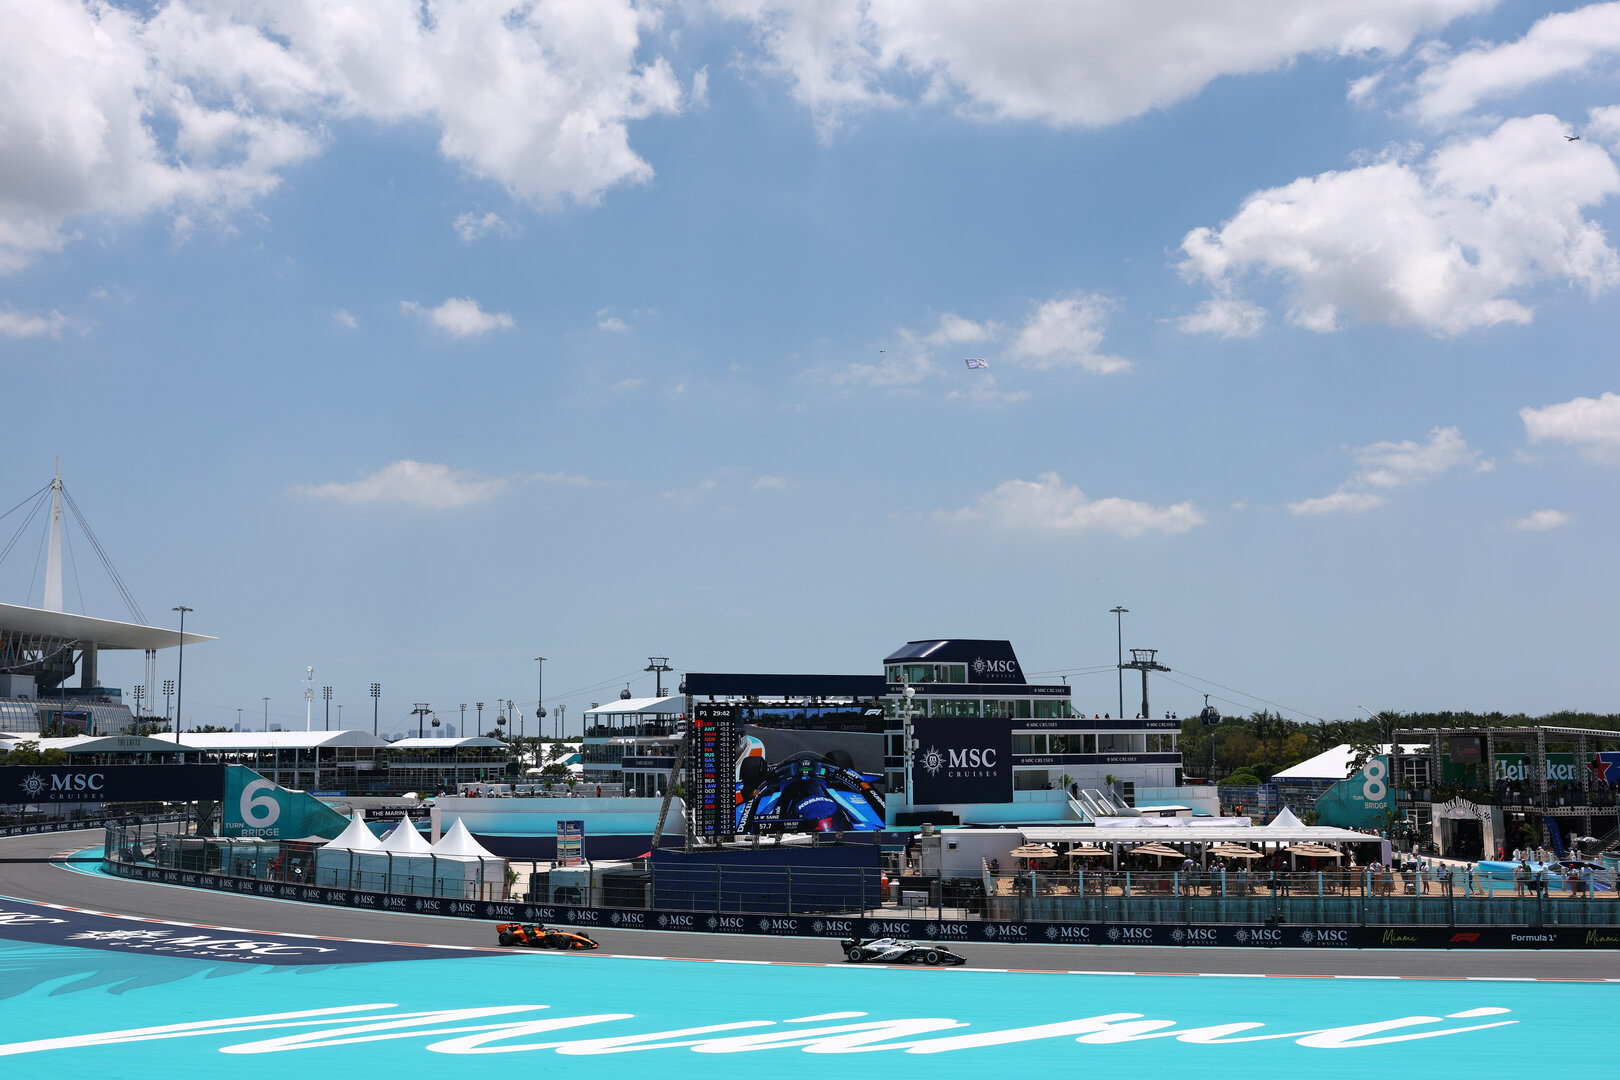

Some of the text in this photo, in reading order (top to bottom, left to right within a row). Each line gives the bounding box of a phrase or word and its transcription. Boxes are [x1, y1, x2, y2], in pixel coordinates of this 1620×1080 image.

[986, 660, 1015, 672] MSC
[948, 749, 996, 768] MSC
[51, 774, 104, 790] MSC
[1363, 760, 1386, 800] 8
[240, 778, 280, 828] 6
[264, 884, 274, 892] MSC
[285, 886, 296, 895] MSC
[308, 889, 320, 898] MSC
[333, 892, 346, 901] MSC
[360, 895, 375, 904] MSC
[390, 898, 406, 906] MSC
[423, 900, 440, 909] MSC
[458, 902, 476, 912] MSC
[496, 906, 514, 915] MSC
[534, 908, 554, 917] MSC
[577, 911, 598, 920] MSC
[622, 913, 644, 923] MSC
[670, 916, 693, 925] MSC
[720, 918, 744, 928] MSC
[772, 920, 797, 929] MSC
[826, 921, 851, 931] MSC
[882, 923, 910, 933] MSC
[940, 925, 968, 934] MSC
[999, 926, 1027, 936] MSC
[1061, 927, 1090, 937] MSC
[1123, 928, 1152, 938] MSC
[1187, 929, 1217, 940] MSC
[1251, 930, 1282, 940] MSC
[1317, 931, 1347, 941] MSC
[1382, 929, 1416, 945] Miami
[142, 936, 337, 955] MSC
